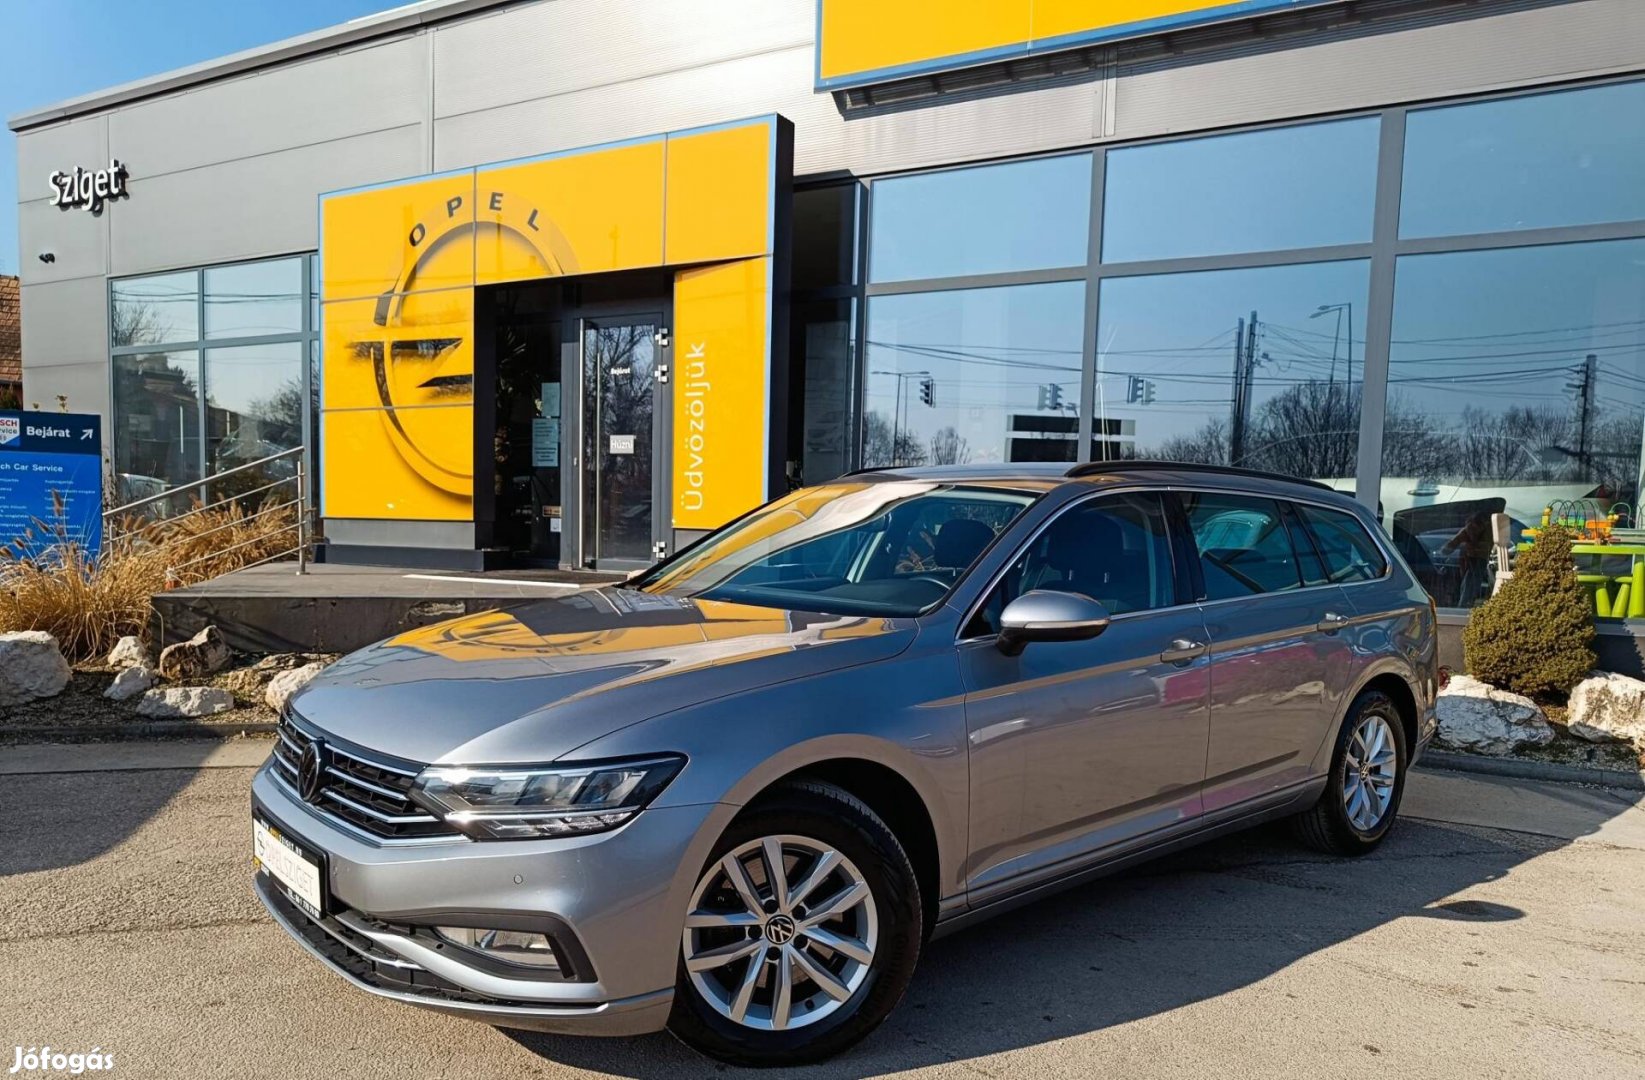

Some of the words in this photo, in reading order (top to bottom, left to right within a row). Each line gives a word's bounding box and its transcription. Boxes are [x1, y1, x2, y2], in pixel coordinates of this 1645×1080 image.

[49, 158, 121, 211] Sziget
[409, 191, 540, 247] OPEL
[26, 425, 71, 439] Bejárat
[680, 342, 711, 510] Üdvözöljük
[13, 462, 29, 471] Car
[32, 463, 63, 473] Service
